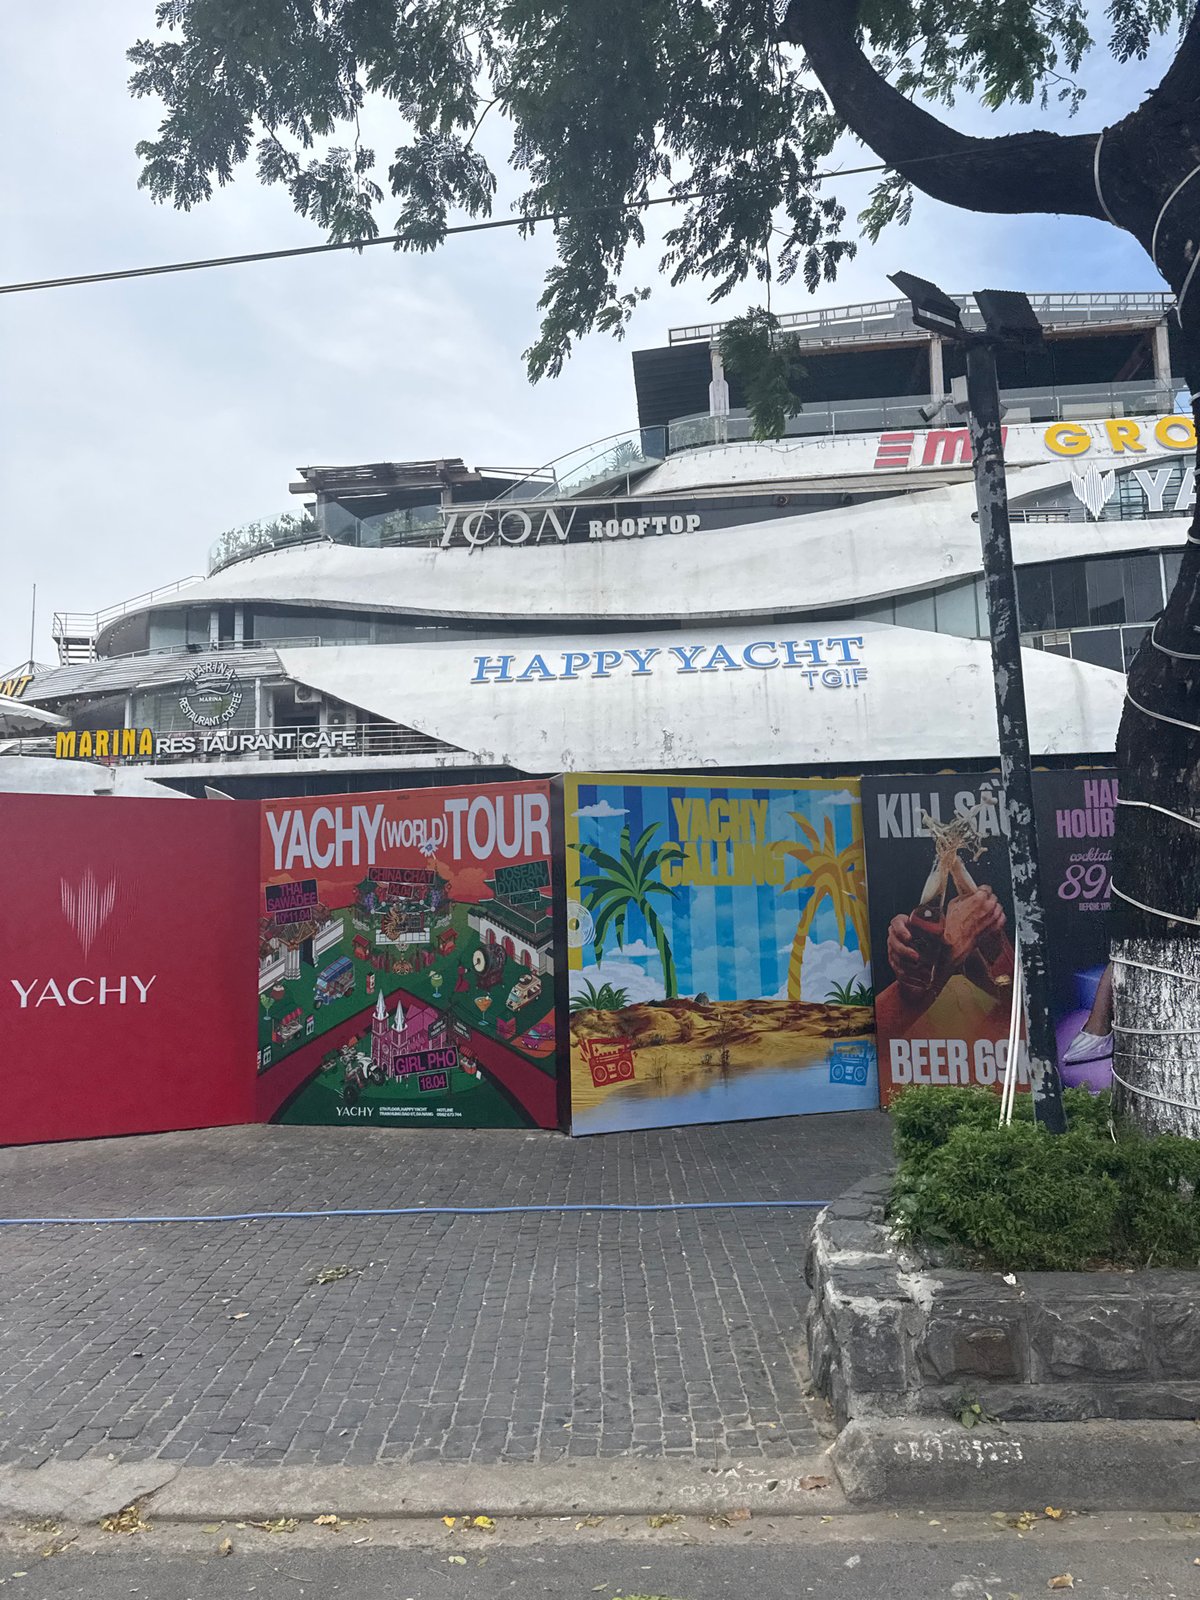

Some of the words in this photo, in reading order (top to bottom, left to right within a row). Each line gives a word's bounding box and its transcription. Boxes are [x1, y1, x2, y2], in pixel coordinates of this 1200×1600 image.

[589, 514, 701, 539] ROOFTOP
[185, 661, 235, 681] MARINA
[470, 648, 660, 685] HAPPY
[669, 636, 866, 675] YACHT
[179, 696, 220, 727] RESTAURANT
[221, 692, 242, 721] COFFEE
[55, 728, 154, 758] MARINA
[301, 730, 357, 750] CAFE
[671, 797, 769, 842] YACHY
[877, 792, 940, 839] KILL
[265, 803, 385, 870] YACHY
[381, 813, 449, 851] (WORLD)
[444, 792, 551, 860] TOUR
[369, 868, 401, 882] CHINA
[403, 870, 434, 884] CHAT
[660, 841, 786, 887] CALLING
[267, 892, 317, 911] SAWADEE
[281, 881, 304, 897] THAI
[10, 974, 157, 1009] YACHY
[395, 1055, 427, 1074] GIRL
[889, 1038, 970, 1085] BEER
[420, 1074, 446, 1090] 18.04
[336, 1106, 374, 1117] YACHY
